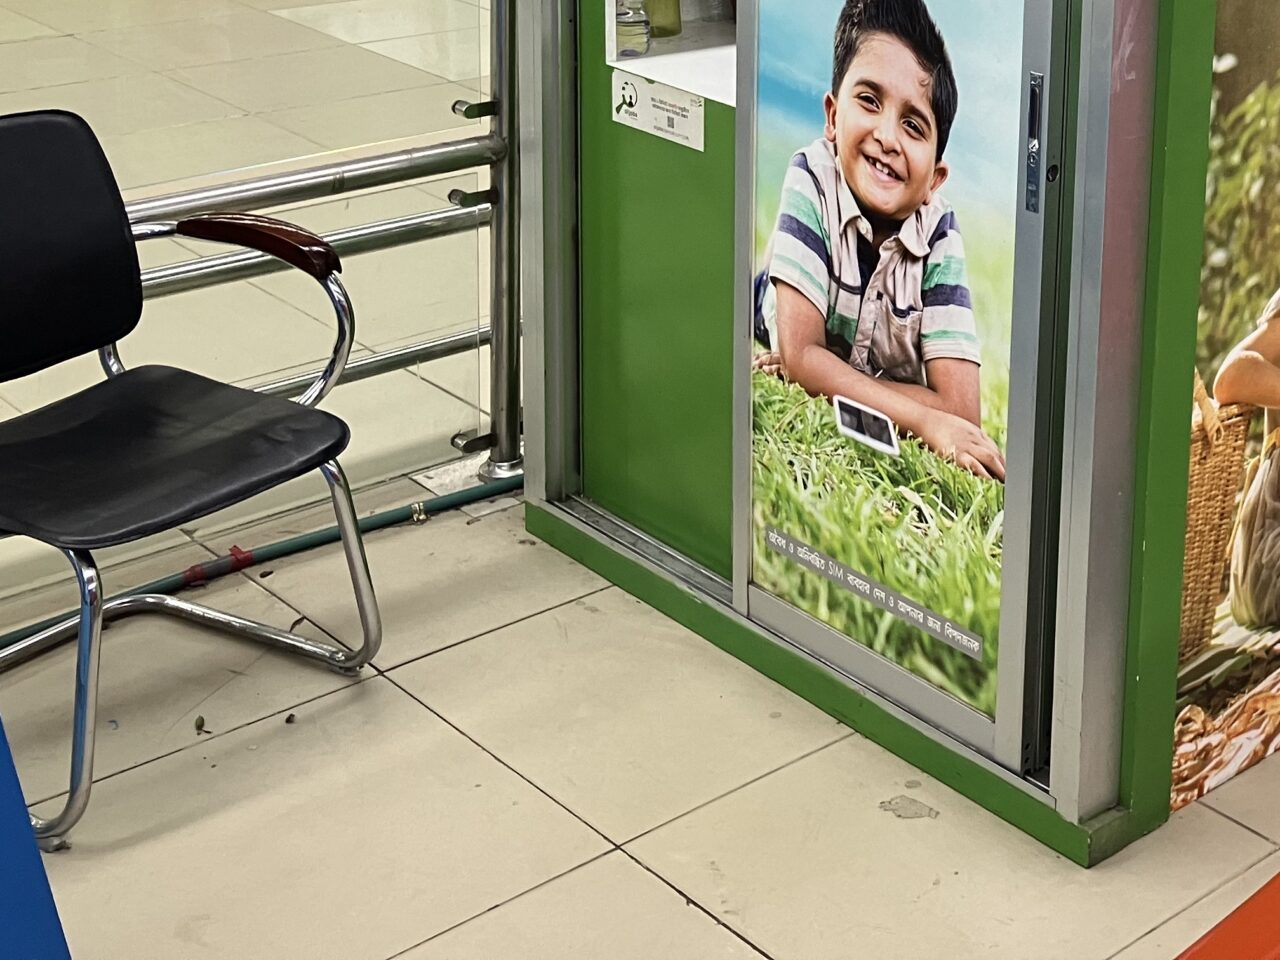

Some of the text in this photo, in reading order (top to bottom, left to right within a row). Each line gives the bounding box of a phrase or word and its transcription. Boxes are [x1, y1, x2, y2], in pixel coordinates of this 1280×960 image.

[788, 543, 794, 553] ও
[828, 561, 844, 581] SIM
[888, 596, 894, 607] ও
